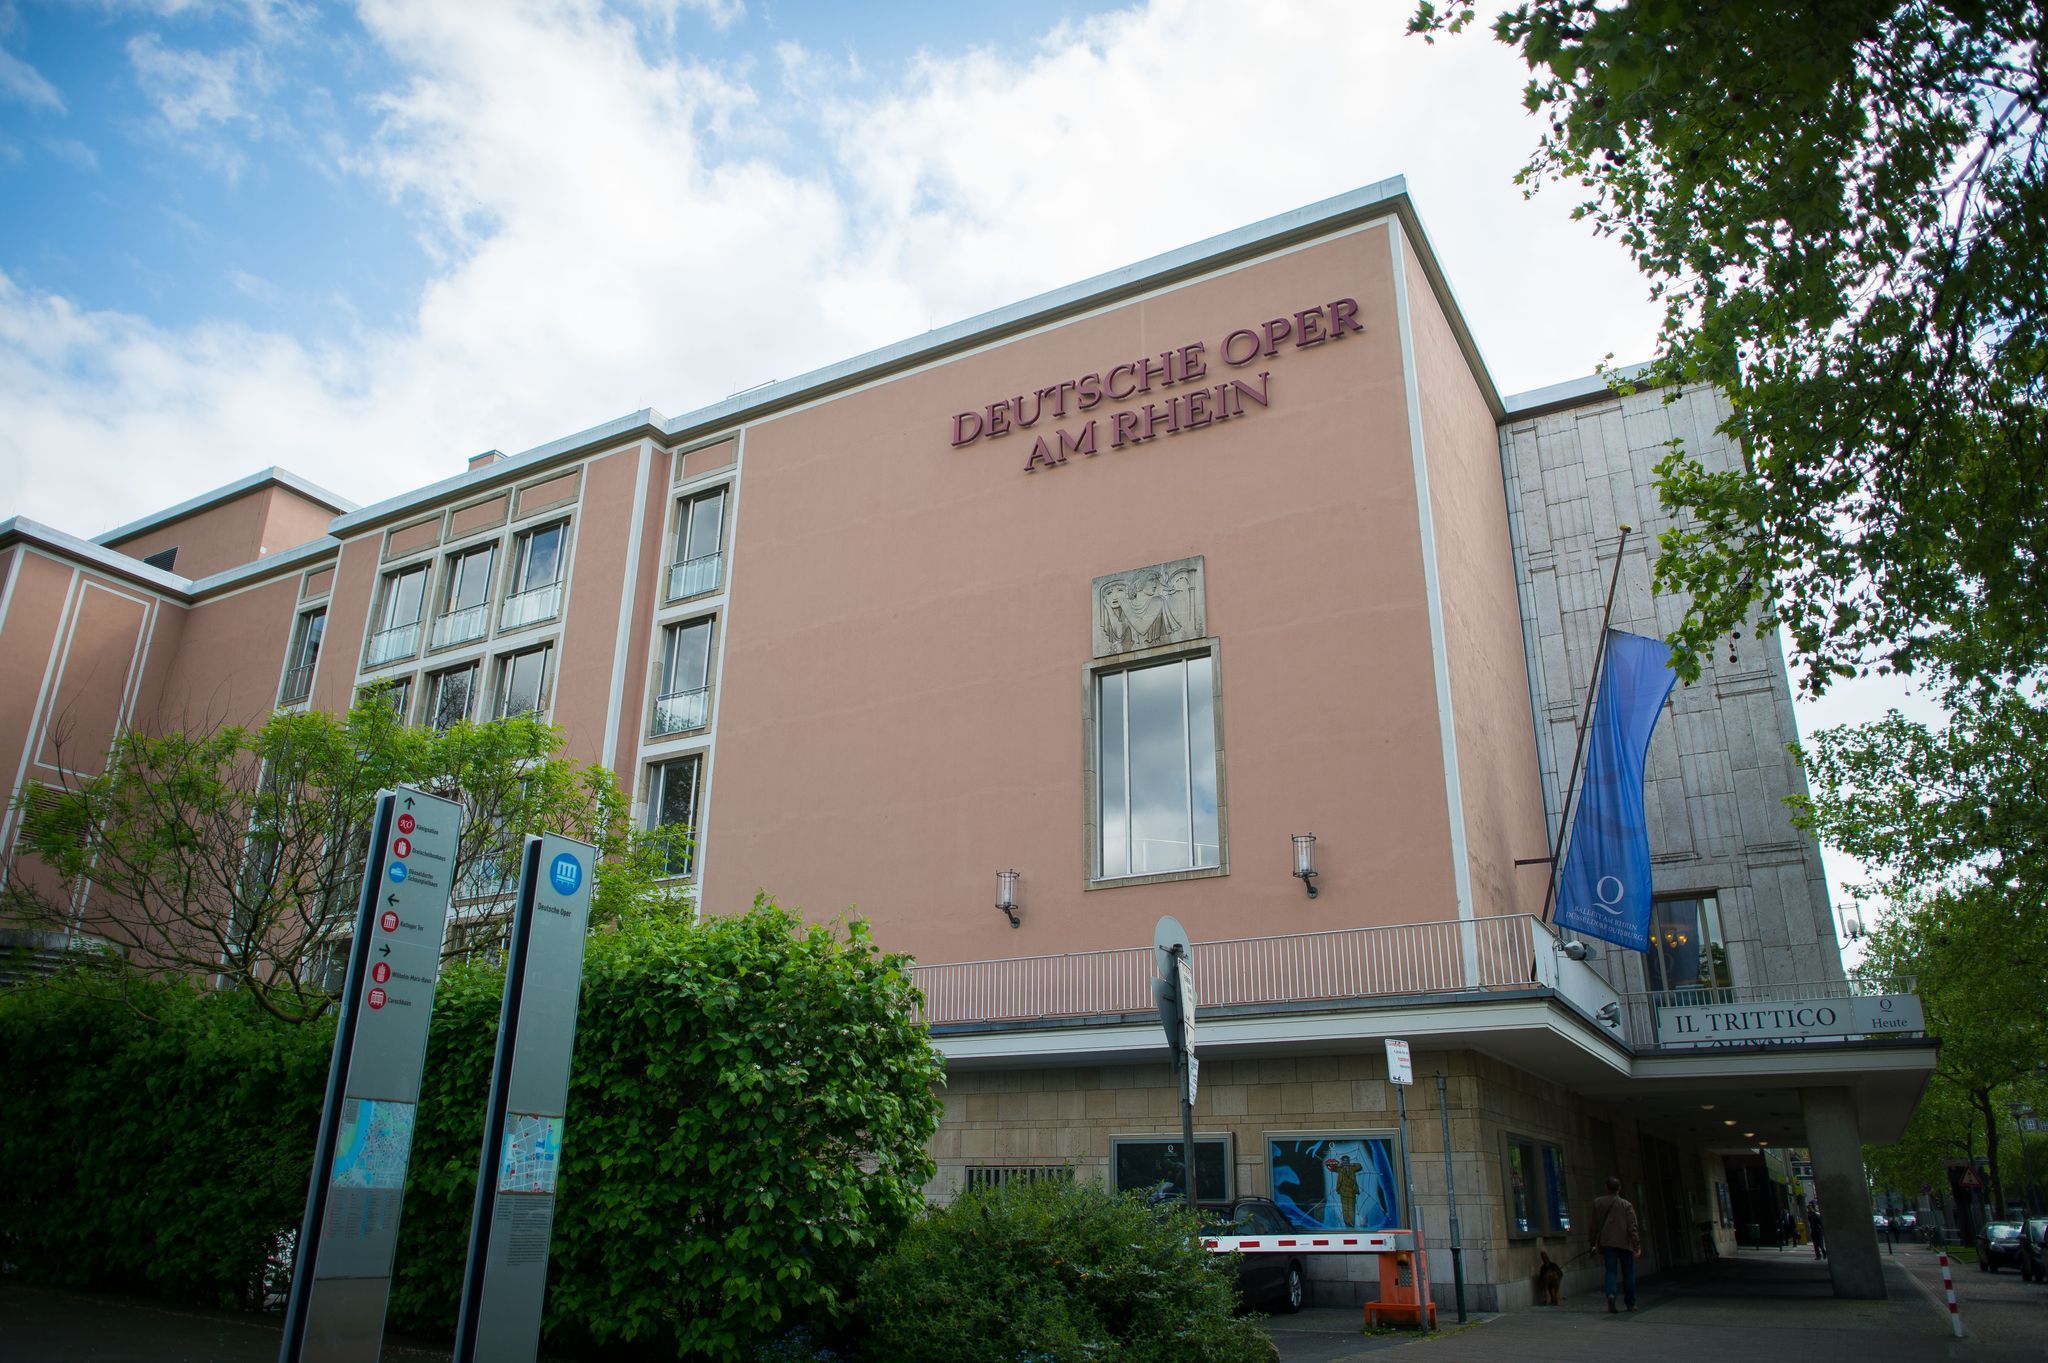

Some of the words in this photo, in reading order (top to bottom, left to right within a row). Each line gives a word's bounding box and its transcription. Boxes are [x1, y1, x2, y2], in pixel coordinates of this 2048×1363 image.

[951, 341, 1207, 447] DEUTSCHE
[1221, 297, 1364, 367] OPER
[1024, 420, 1097, 472] AM
[1111, 371, 1270, 447] RHEIN
[537, 902, 560, 914] Deutsche
[560, 908, 571, 918] Oper
[1574, 905, 1603, 920] BALLETT
[1603, 915, 1614, 924] AM
[1614, 918, 1639, 931] RHEIN
[1565, 911, 1608, 931] DÜSSELDORF
[1608, 926, 1644, 941] DUISBURG
[1675, 1014, 1700, 1033] IL
[1705, 1007, 1836, 1032] TRITTICO
[1872, 1017, 1908, 1029] Heute
